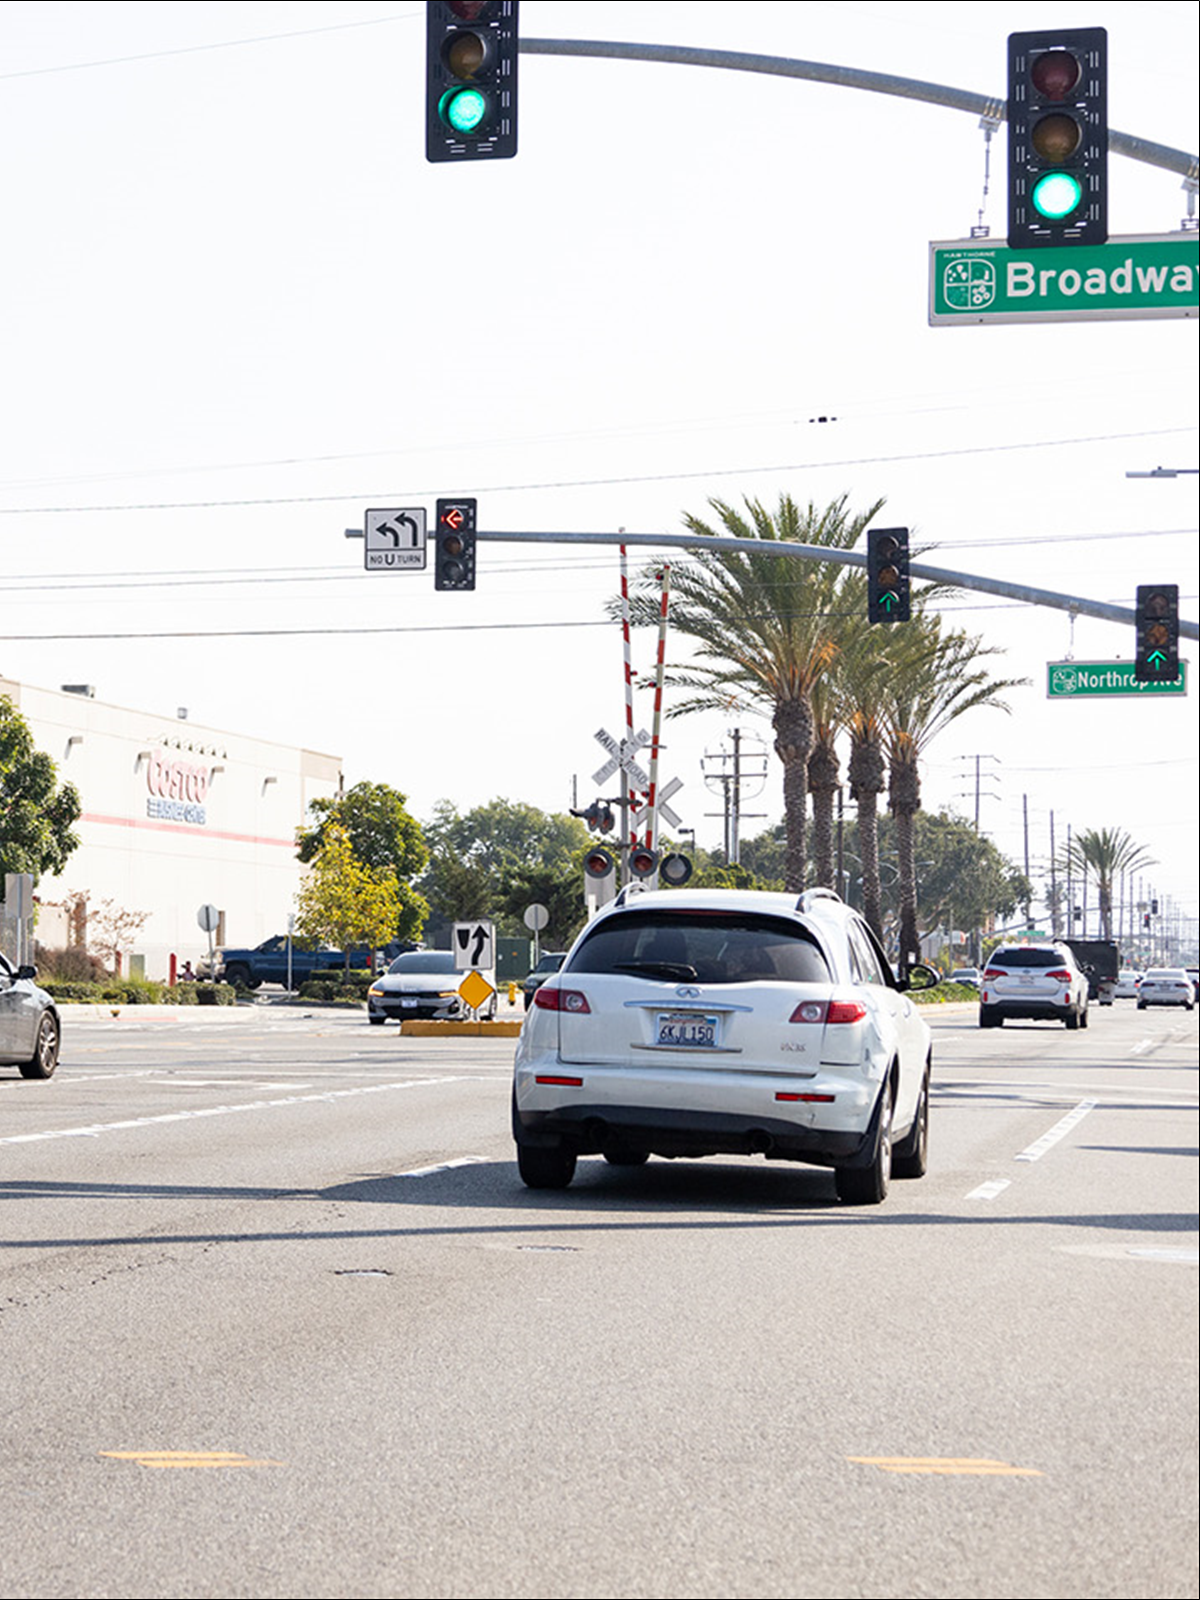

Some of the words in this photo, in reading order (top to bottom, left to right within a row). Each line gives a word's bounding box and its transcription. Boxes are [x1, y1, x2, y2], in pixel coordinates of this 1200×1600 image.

[1006, 258, 1198, 297] Broadwa
[370, 555, 383, 565] NO
[385, 554, 395, 566] U
[397, 554, 421, 564] TURN
[595, 730, 617, 754] RAIL
[624, 760, 648, 785] ROAD
[660, 1026, 714, 1041] 6KJL150
